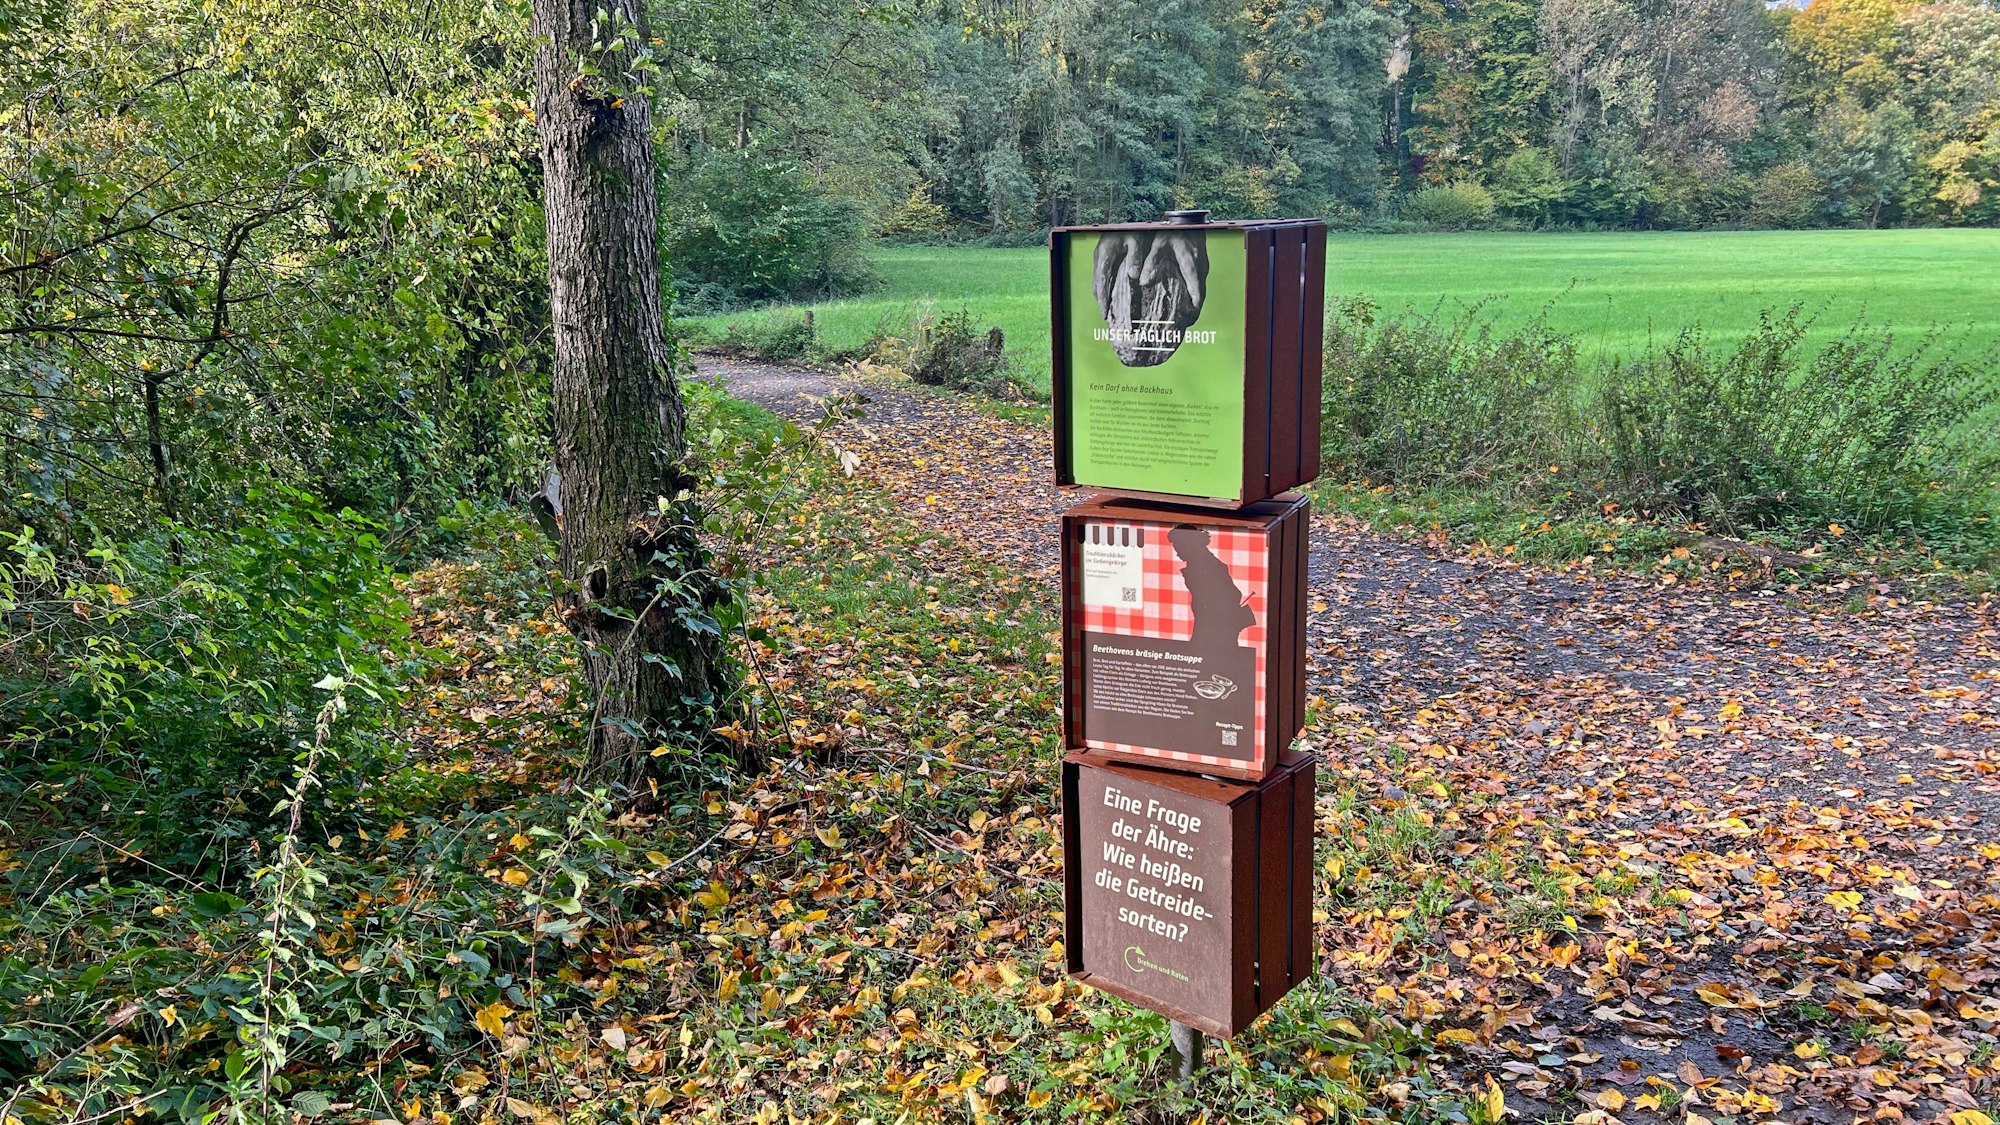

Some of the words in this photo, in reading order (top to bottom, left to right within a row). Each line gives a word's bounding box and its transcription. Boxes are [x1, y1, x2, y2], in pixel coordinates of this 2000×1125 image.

[1093, 327, 1131, 343] UNSER
[1134, 326, 1181, 344] TÄGLICH
[1185, 330, 1217, 345] BROT
[1090, 383, 1104, 391] Kein
[1105, 383, 1120, 394] Dorf
[1122, 385, 1138, 393] ohne
[1140, 385, 1174, 395] Backhaus
[1086, 550, 1126, 559] Traditionsbäcker
[1093, 558, 1127, 567] Siebengebirge
[1093, 644, 1134, 656] Beethovens
[1136, 648, 1163, 660] bräsige
[1164, 652, 1203, 664] Brotsuppe
[1104, 786, 1142, 816] Eine
[1146, 798, 1202, 834] Frage
[1112, 818, 1142, 842] der
[1144, 824, 1194, 860] Ähre:
[1103, 841, 1136, 869] Wie
[1140, 853, 1204, 892] heißen
[1095, 868, 1122, 892] die
[1126, 878, 1214, 921] Getreide-
[1118, 906, 1189, 942] sorten?
[1137, 957, 1158, 971] Drehen
[1159, 966, 1170, 975] und
[1171, 969, 1188, 982] Raten
